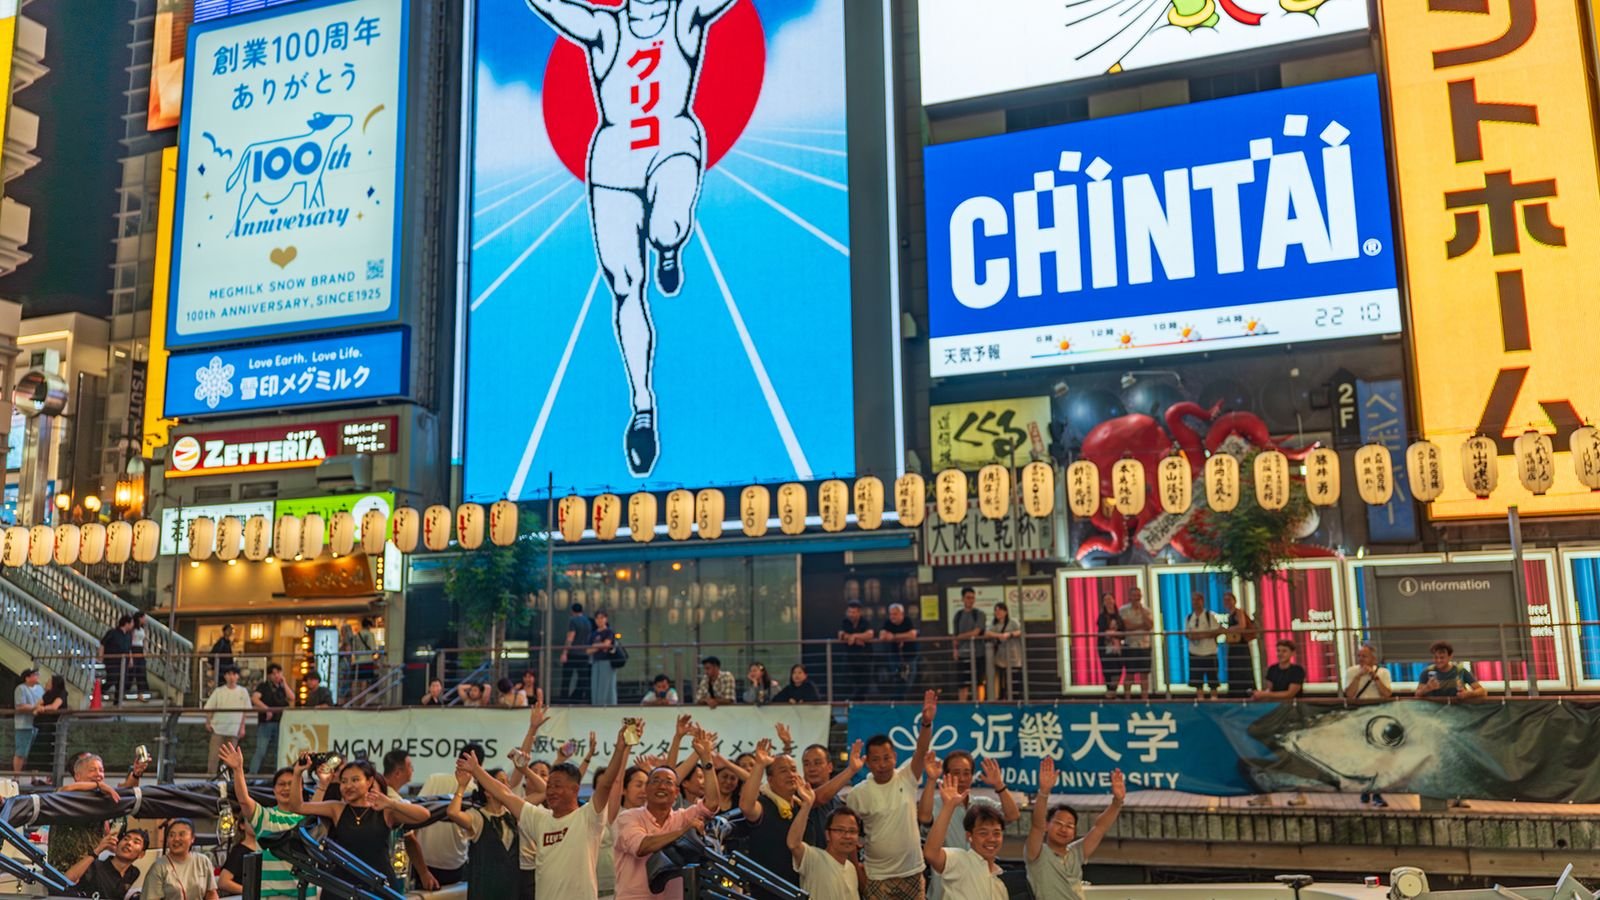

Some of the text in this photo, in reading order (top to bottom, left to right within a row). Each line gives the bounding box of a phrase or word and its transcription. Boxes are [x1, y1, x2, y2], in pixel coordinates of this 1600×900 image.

[212, 16, 382, 78] 創業100周年
[232, 62, 356, 111] ありがとう
[627, 40, 664, 151] グリコ
[251, 142, 353, 184] 100th
[226, 205, 351, 240] Anniversary
[949, 113, 1360, 310] CHINTAI
[209, 271, 356, 300] MEGMILK SNOW BRAND
[186, 308, 217, 322] 100th
[316, 288, 382, 308] SINCE1925
[1315, 306, 1344, 327] 22
[249, 347, 363, 370] Love Earth. Love Life.
[943, 342, 1001, 364] 天気予報
[240, 366, 371, 401] 雪印メグミルク
[1337, 383, 1355, 429] 2F
[953, 409, 1028, 458] くくる
[203, 437, 326, 468] ZETTERIA
[1420, 577, 1491, 592] information
[332, 738, 384, 758] MGM
[970, 710, 1180, 763] 近畿大学
[1050, 768, 1180, 790] NIVESITY
